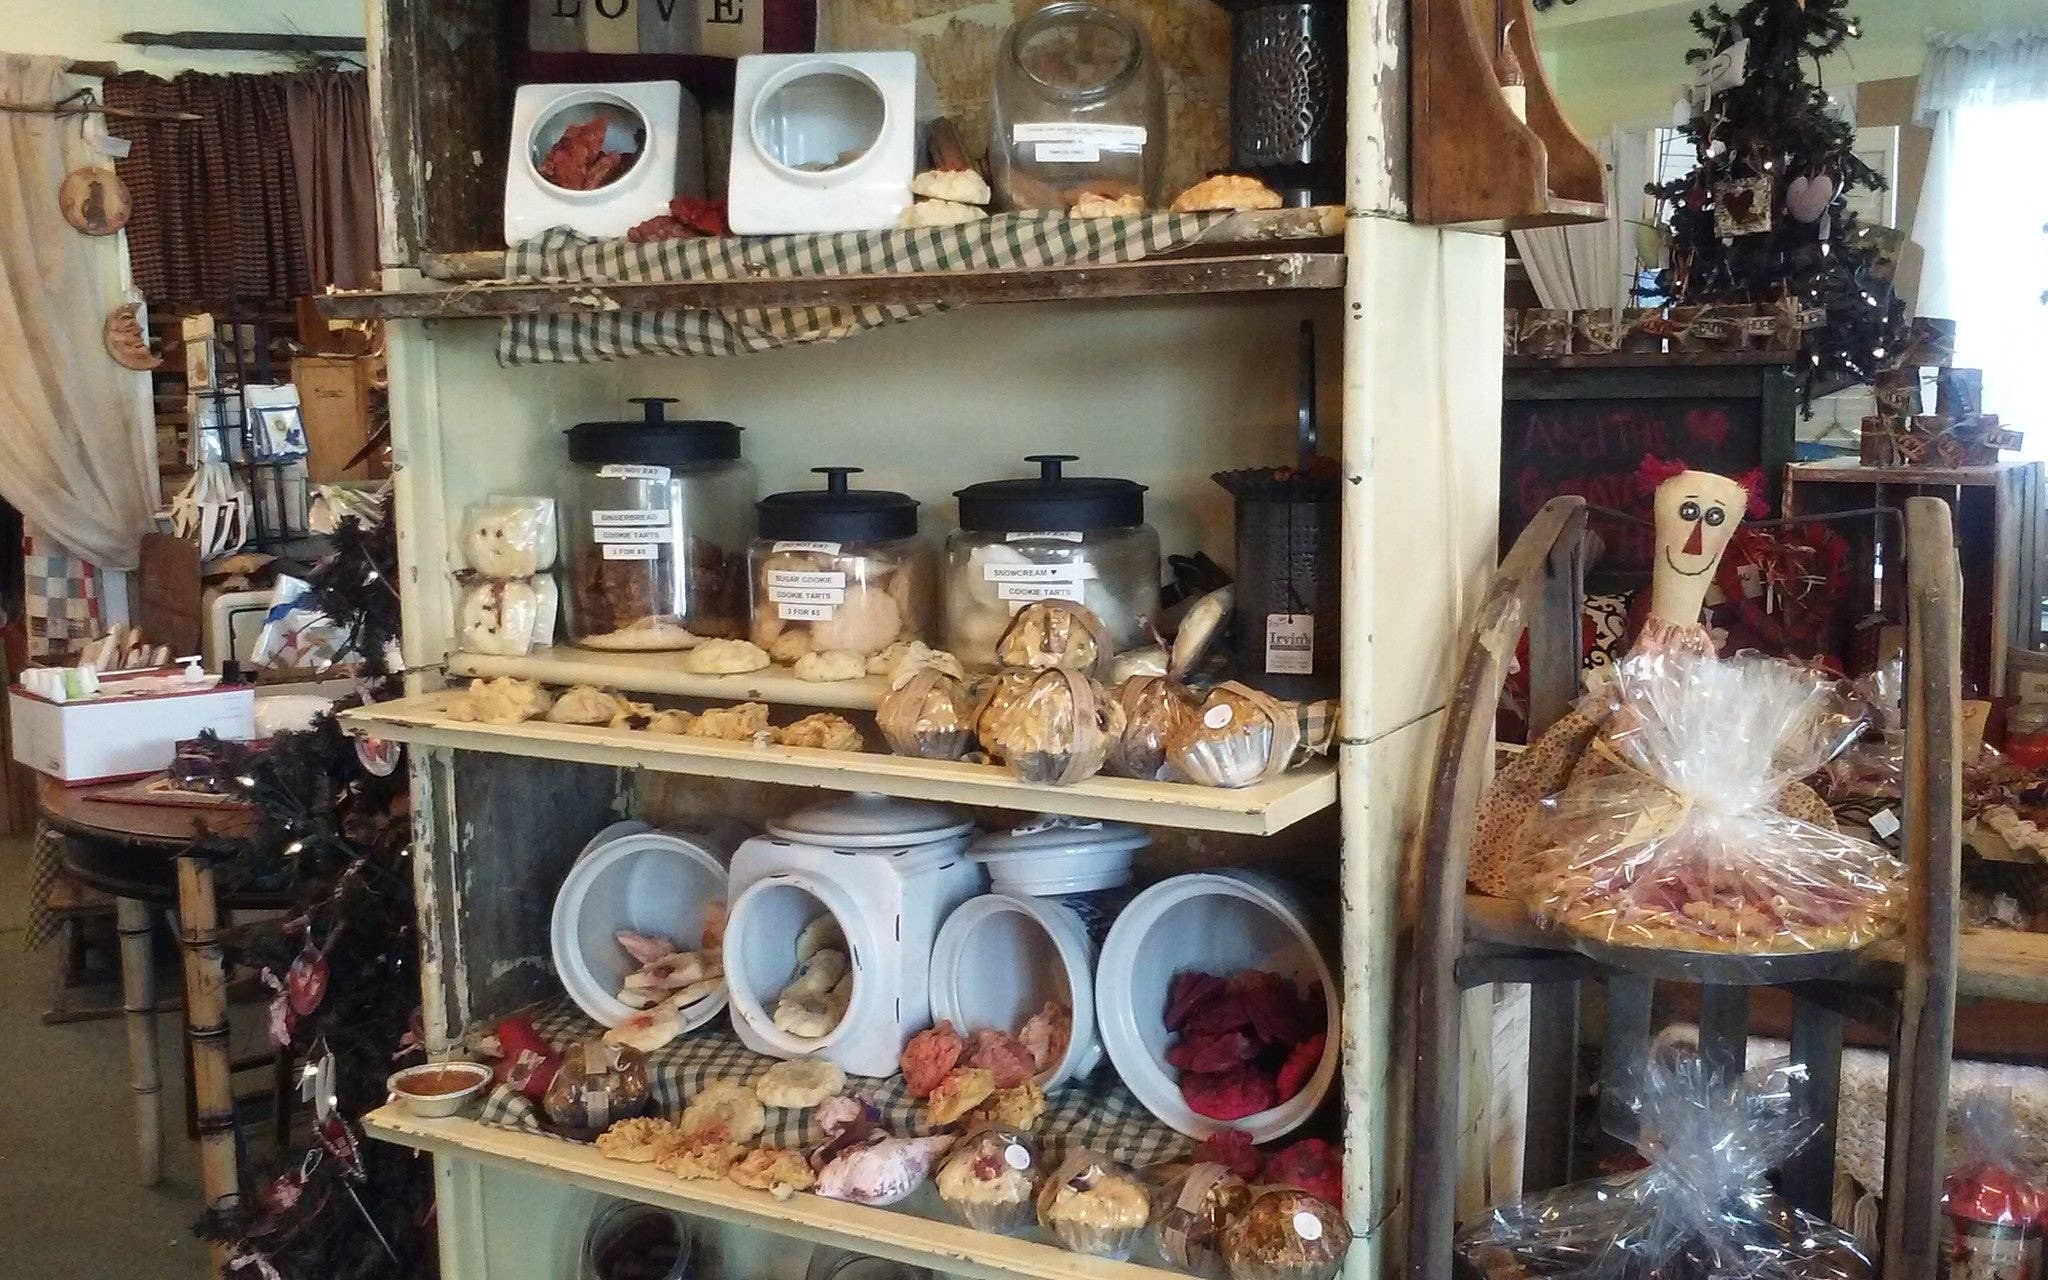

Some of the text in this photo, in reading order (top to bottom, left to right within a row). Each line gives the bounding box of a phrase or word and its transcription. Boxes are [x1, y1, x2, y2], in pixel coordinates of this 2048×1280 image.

[551, 0, 743, 23] LOVE
[993, 569, 1048, 577] SNOWCREAM
[801, 576, 832, 584] COOKIE
[776, 591, 831, 600] COOKIE TARTS
[1008, 587, 1072, 596] COOKIE TARTS
